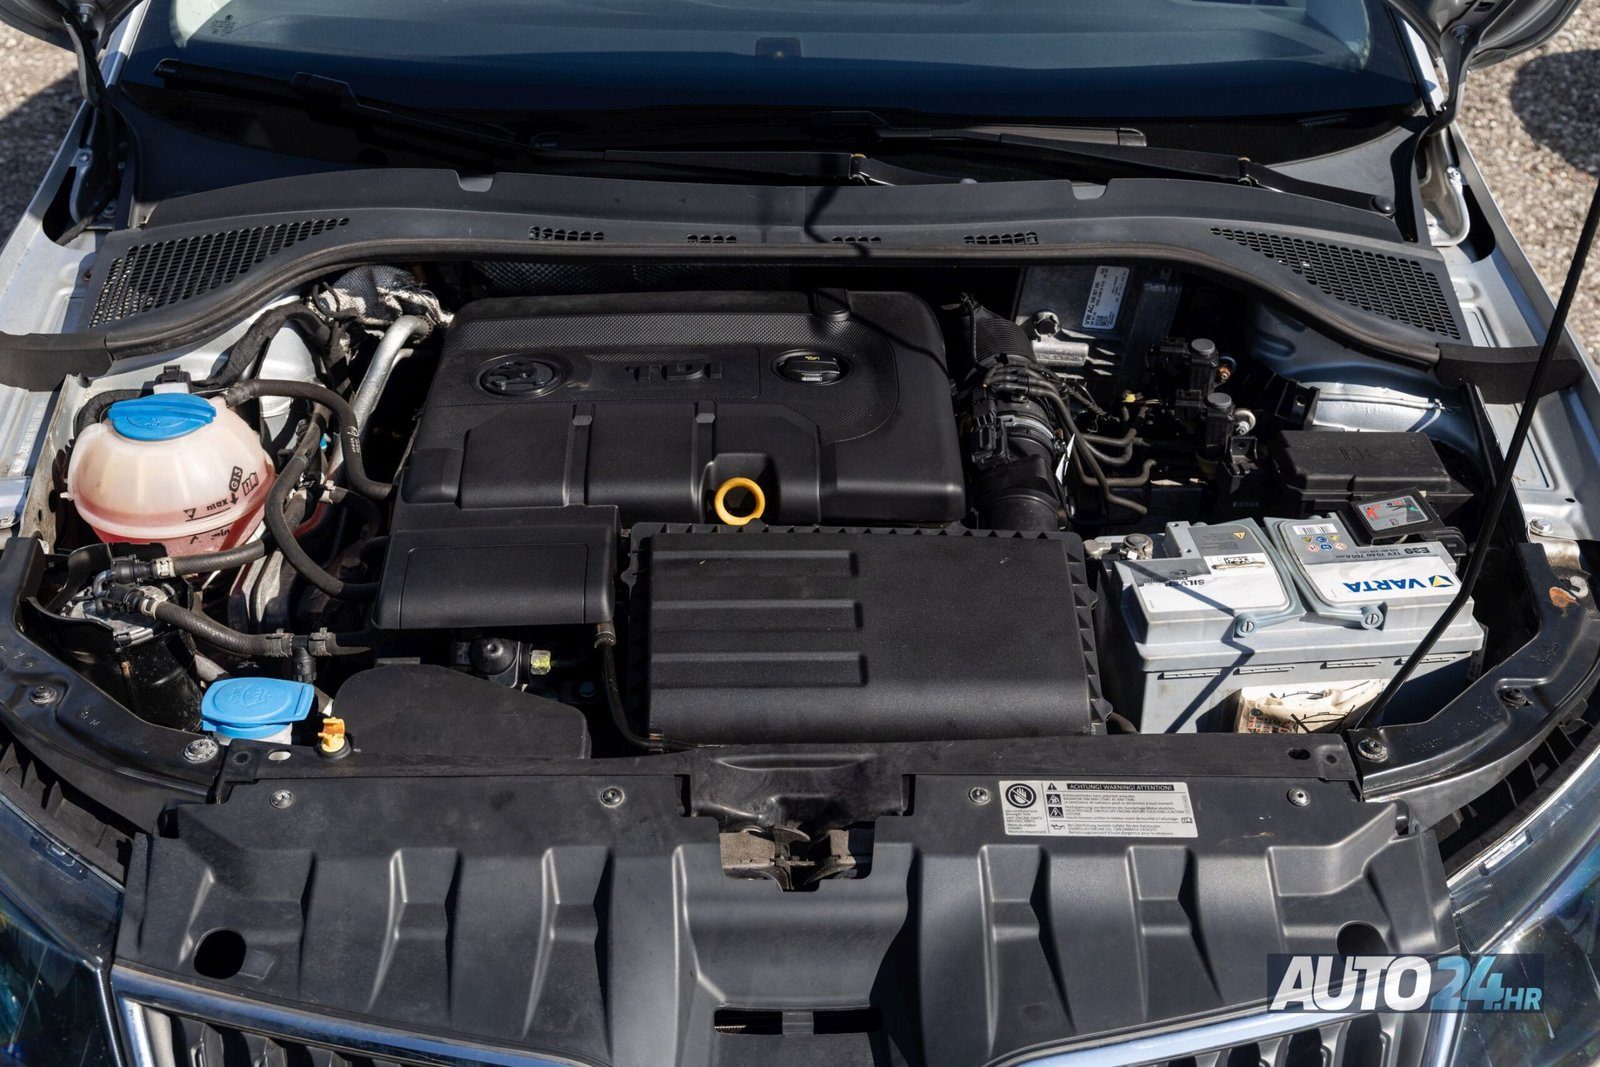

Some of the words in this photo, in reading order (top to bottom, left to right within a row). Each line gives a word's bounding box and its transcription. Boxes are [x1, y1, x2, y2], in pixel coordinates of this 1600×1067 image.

[624, 361, 723, 382] TDI
[206, 499, 229, 511] max
[1342, 578, 1427, 593] VARTA
